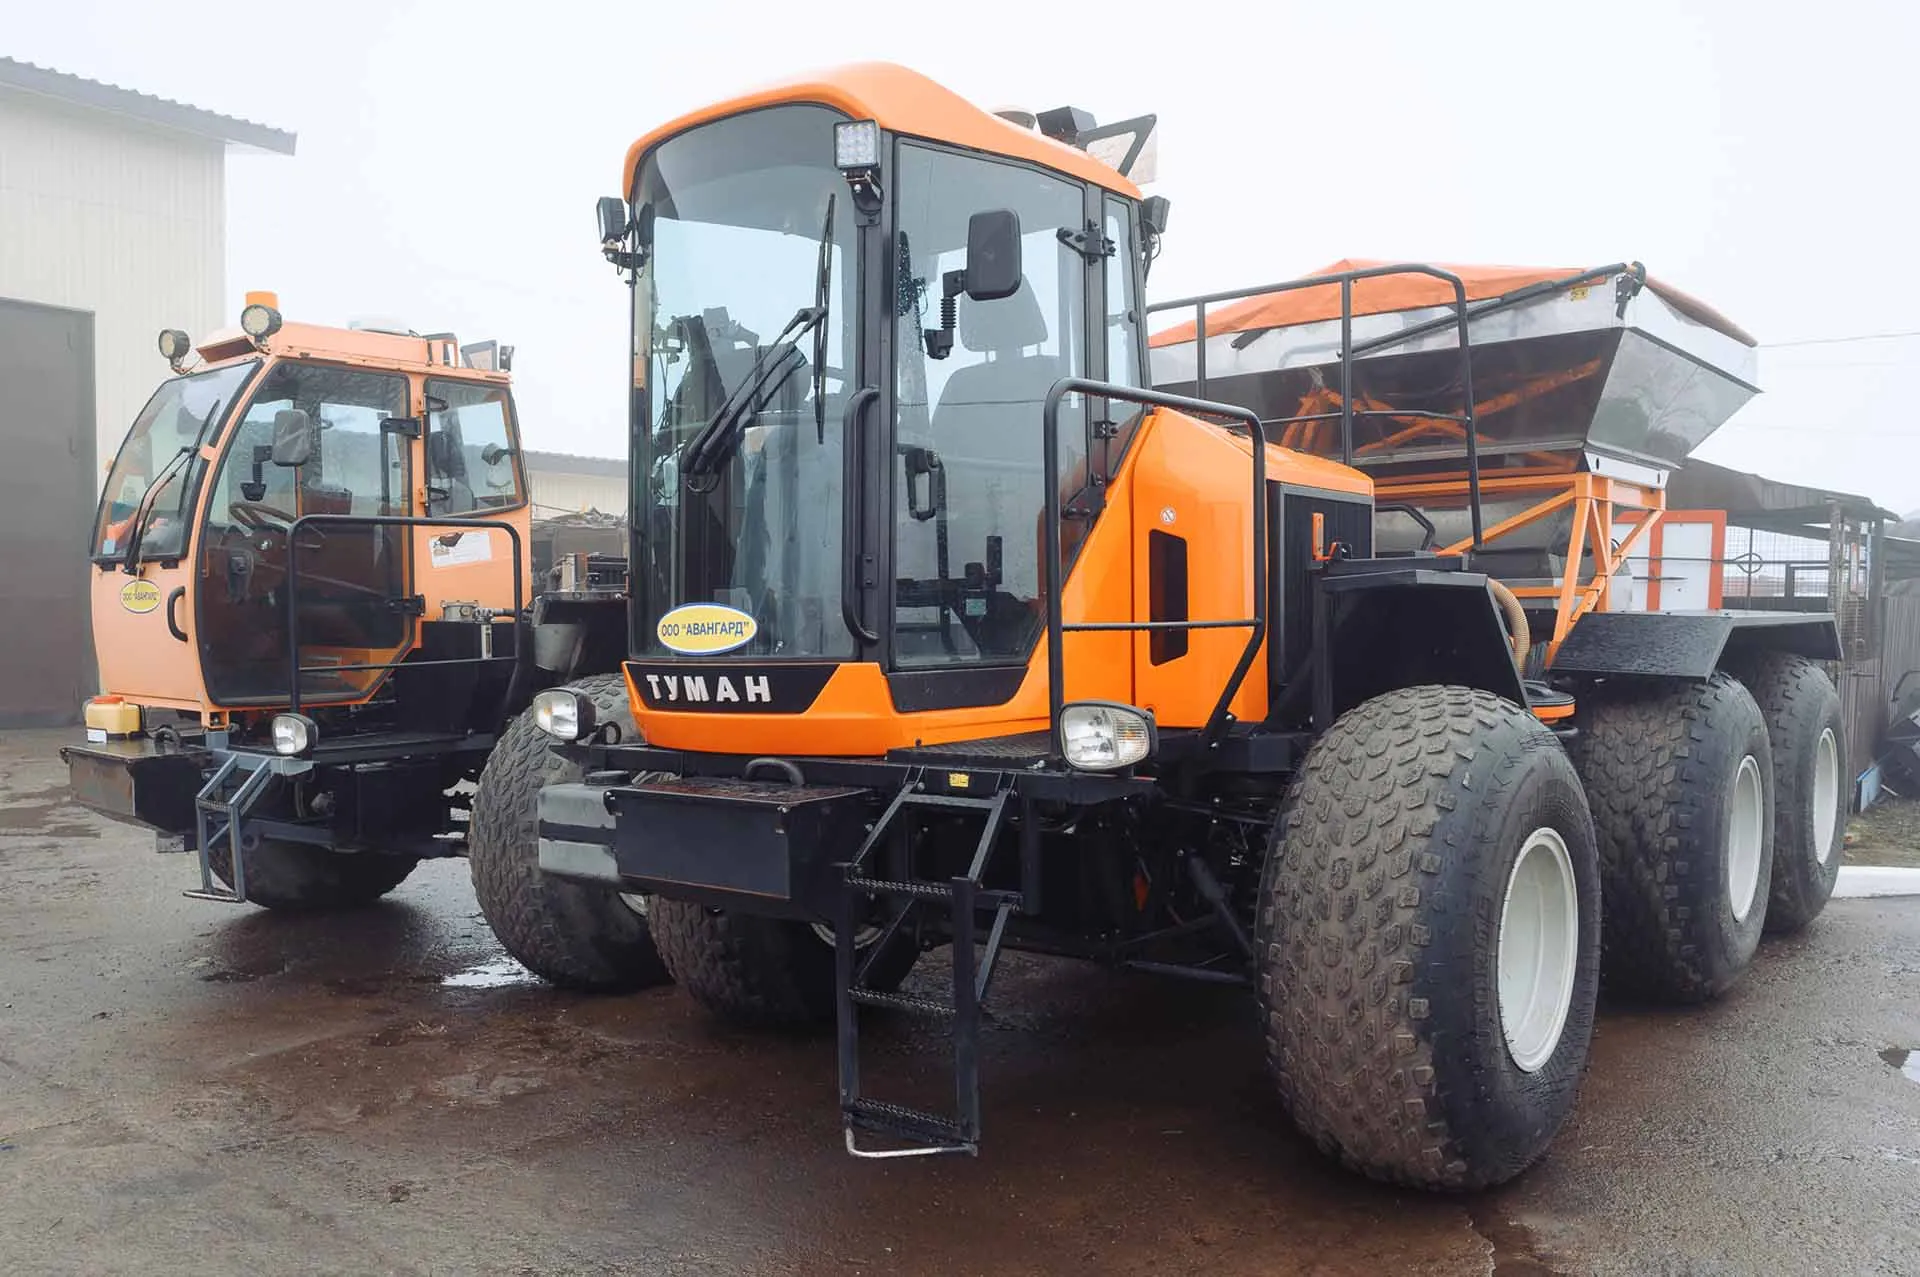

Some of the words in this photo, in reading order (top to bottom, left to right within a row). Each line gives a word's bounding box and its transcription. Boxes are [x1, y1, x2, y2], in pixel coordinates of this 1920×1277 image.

[661, 623, 680, 637] ООО
[681, 621, 750, 637] "АВАНГАРД"
[645, 674, 772, 702] ТУМАН
